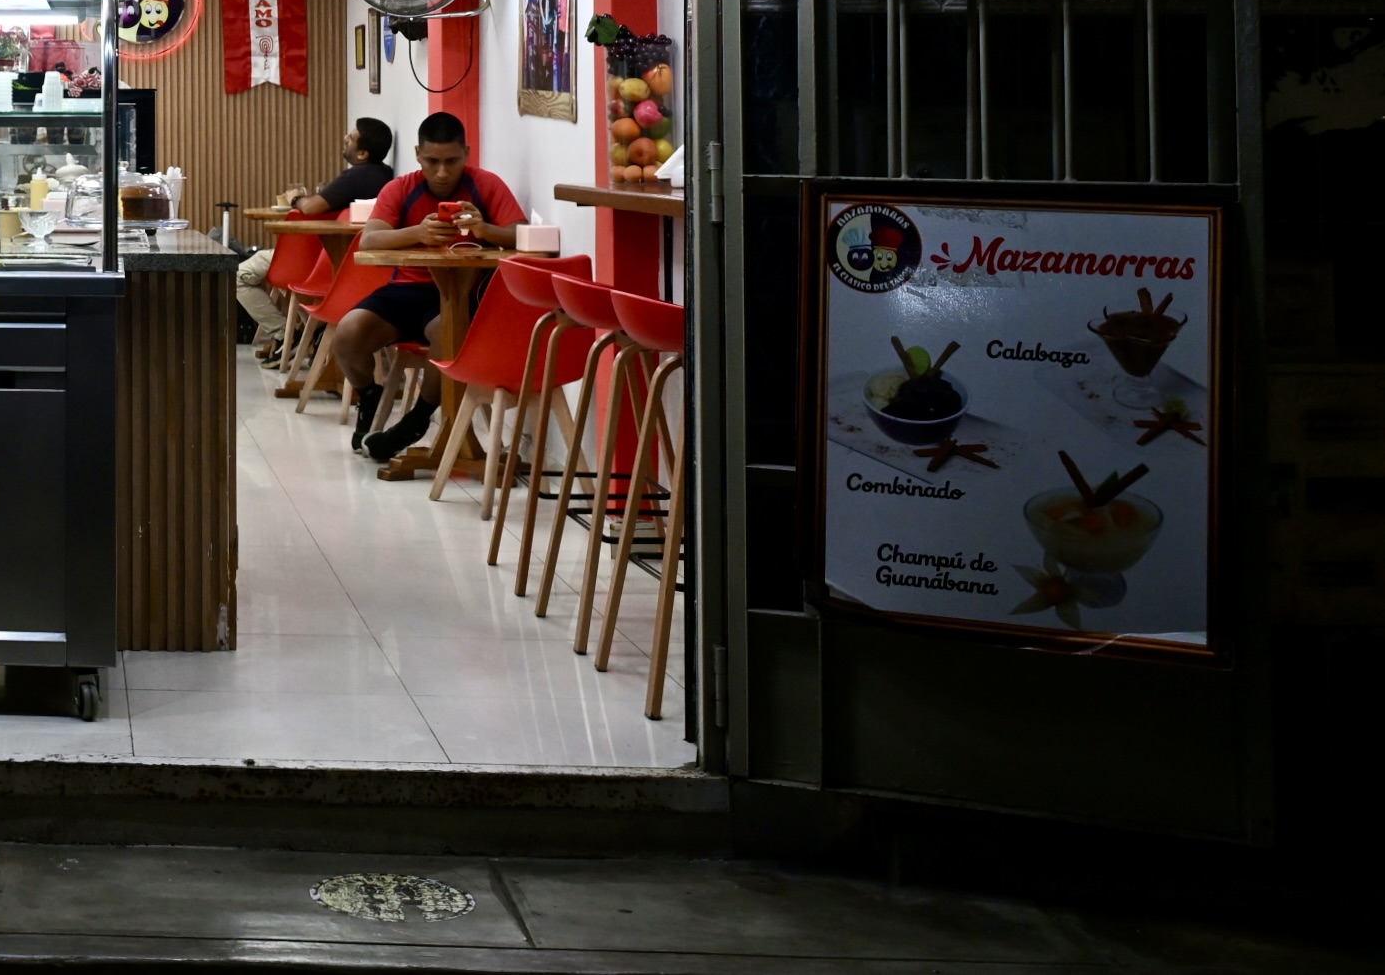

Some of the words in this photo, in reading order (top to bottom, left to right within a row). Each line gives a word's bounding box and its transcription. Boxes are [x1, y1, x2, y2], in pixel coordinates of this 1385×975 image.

[952, 235, 1196, 280] Mazamorras
[839, 271, 872, 290] CLASICO
[986, 340, 1090, 368] Calabaza
[846, 472, 966, 501] Combinado
[877, 542, 967, 574] Champú
[969, 550, 998, 573] de
[875, 565, 999, 597] Guanábana
